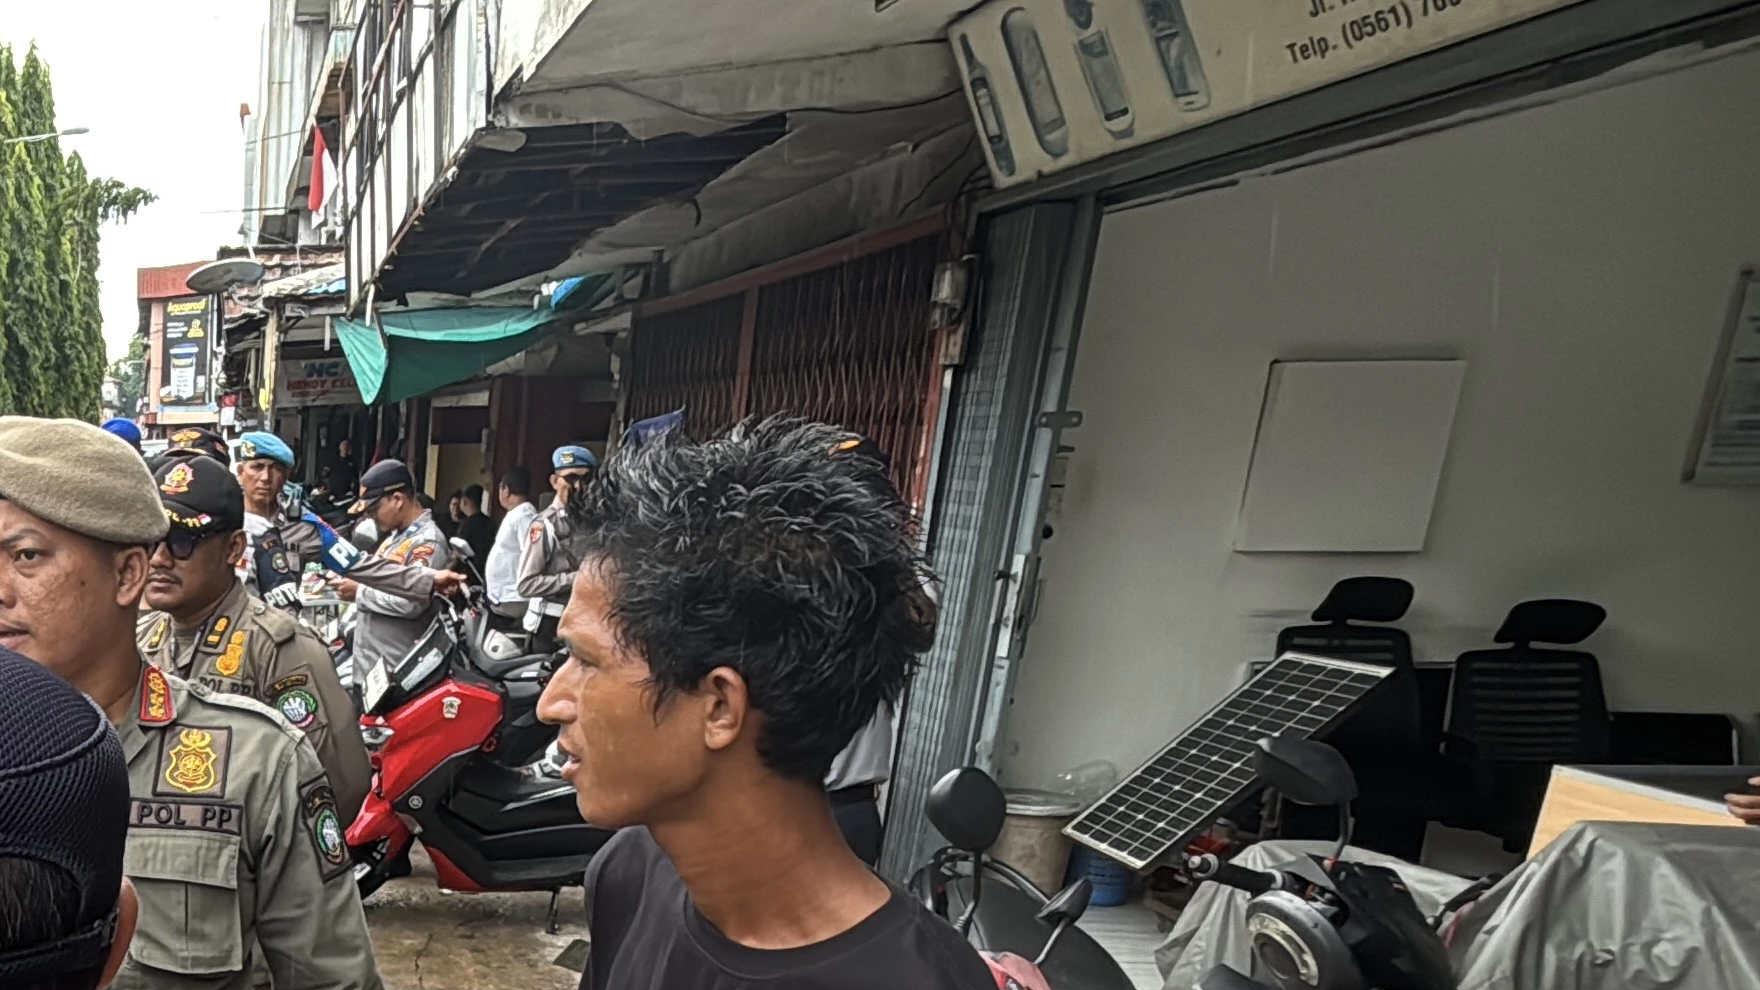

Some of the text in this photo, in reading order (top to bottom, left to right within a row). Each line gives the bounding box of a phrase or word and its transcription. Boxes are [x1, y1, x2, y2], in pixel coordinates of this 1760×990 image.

[1285, 35, 1337, 64] Telp.
[1341, 3, 1413, 49] (0561)
[136, 803, 232, 828] POL PP
